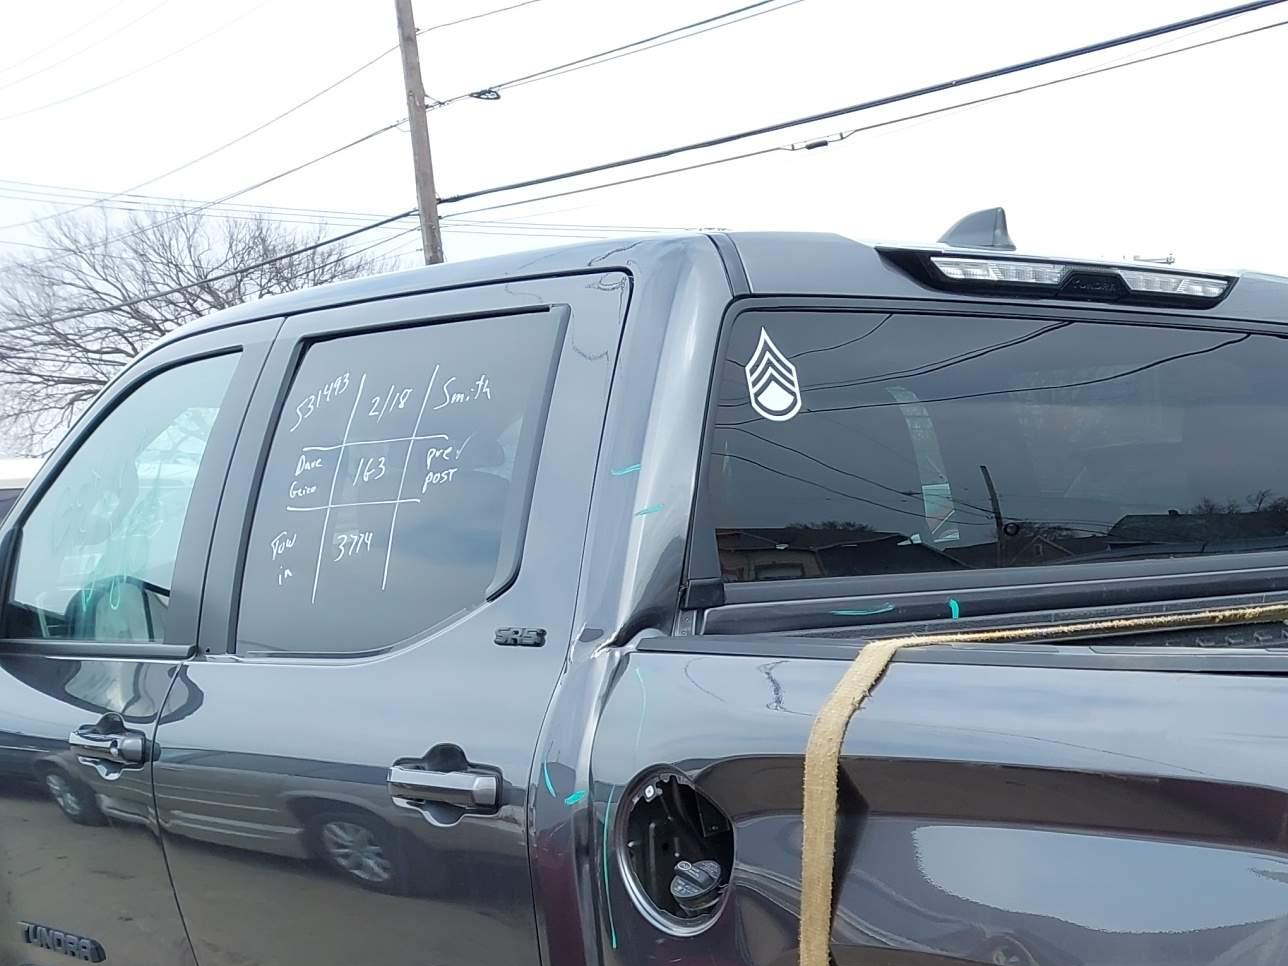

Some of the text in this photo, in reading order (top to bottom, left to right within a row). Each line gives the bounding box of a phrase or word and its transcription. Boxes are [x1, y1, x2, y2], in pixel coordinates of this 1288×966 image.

[289, 372, 351, 432] 531493
[368, 384, 414, 424] 2/18
[433, 374, 492, 410] Smith
[353, 456, 386, 487] 163
[271, 531, 297, 560] Tow
[278, 566, 293, 585] in
[493, 627, 547, 648] SR5
[16, 920, 107, 963] TUNDRA
